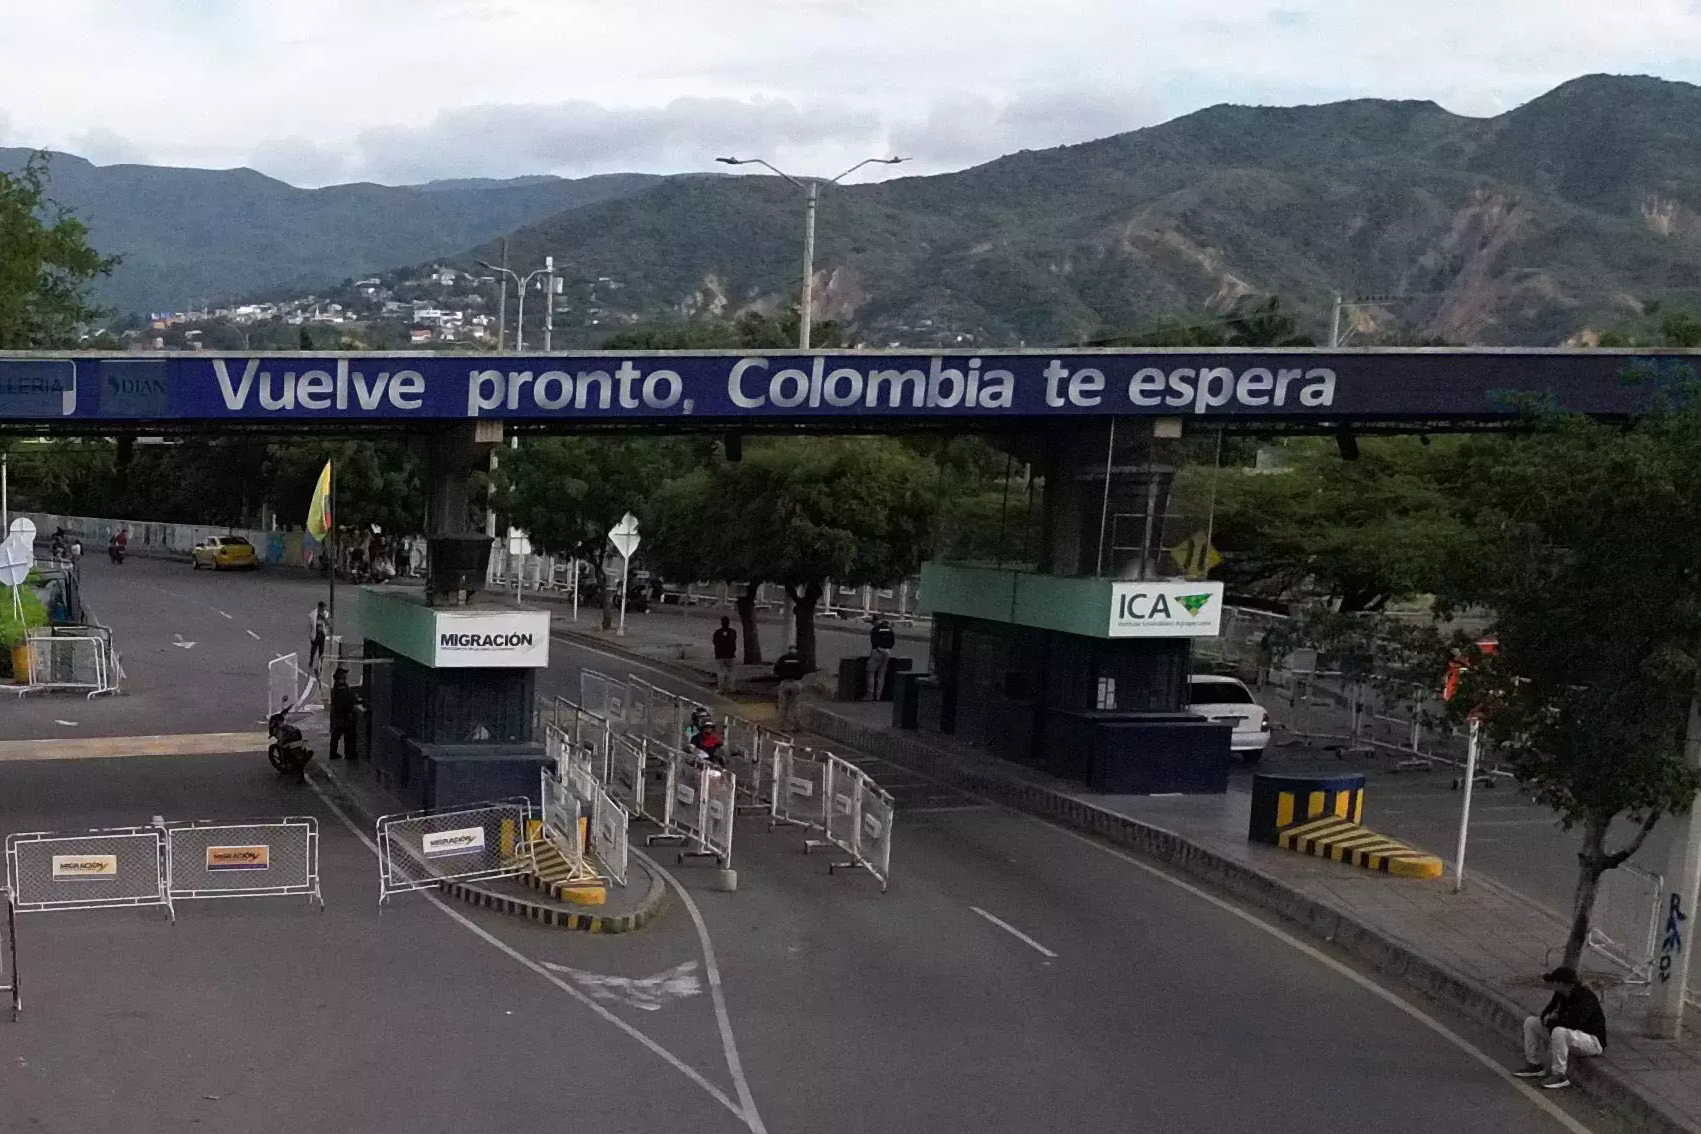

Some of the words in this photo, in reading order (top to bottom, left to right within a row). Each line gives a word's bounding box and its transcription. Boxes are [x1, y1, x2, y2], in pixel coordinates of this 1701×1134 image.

[122, 379, 166, 394] DIAN
[213, 358, 425, 411] Vuelve
[468, 360, 694, 417] pronto,
[728, 356, 1013, 409] Colombia
[1043, 359, 1105, 409] te
[1128, 366, 1337, 414] espera
[1119, 593, 1171, 619] ICA
[440, 632, 533, 647] MIGRACIÓN
